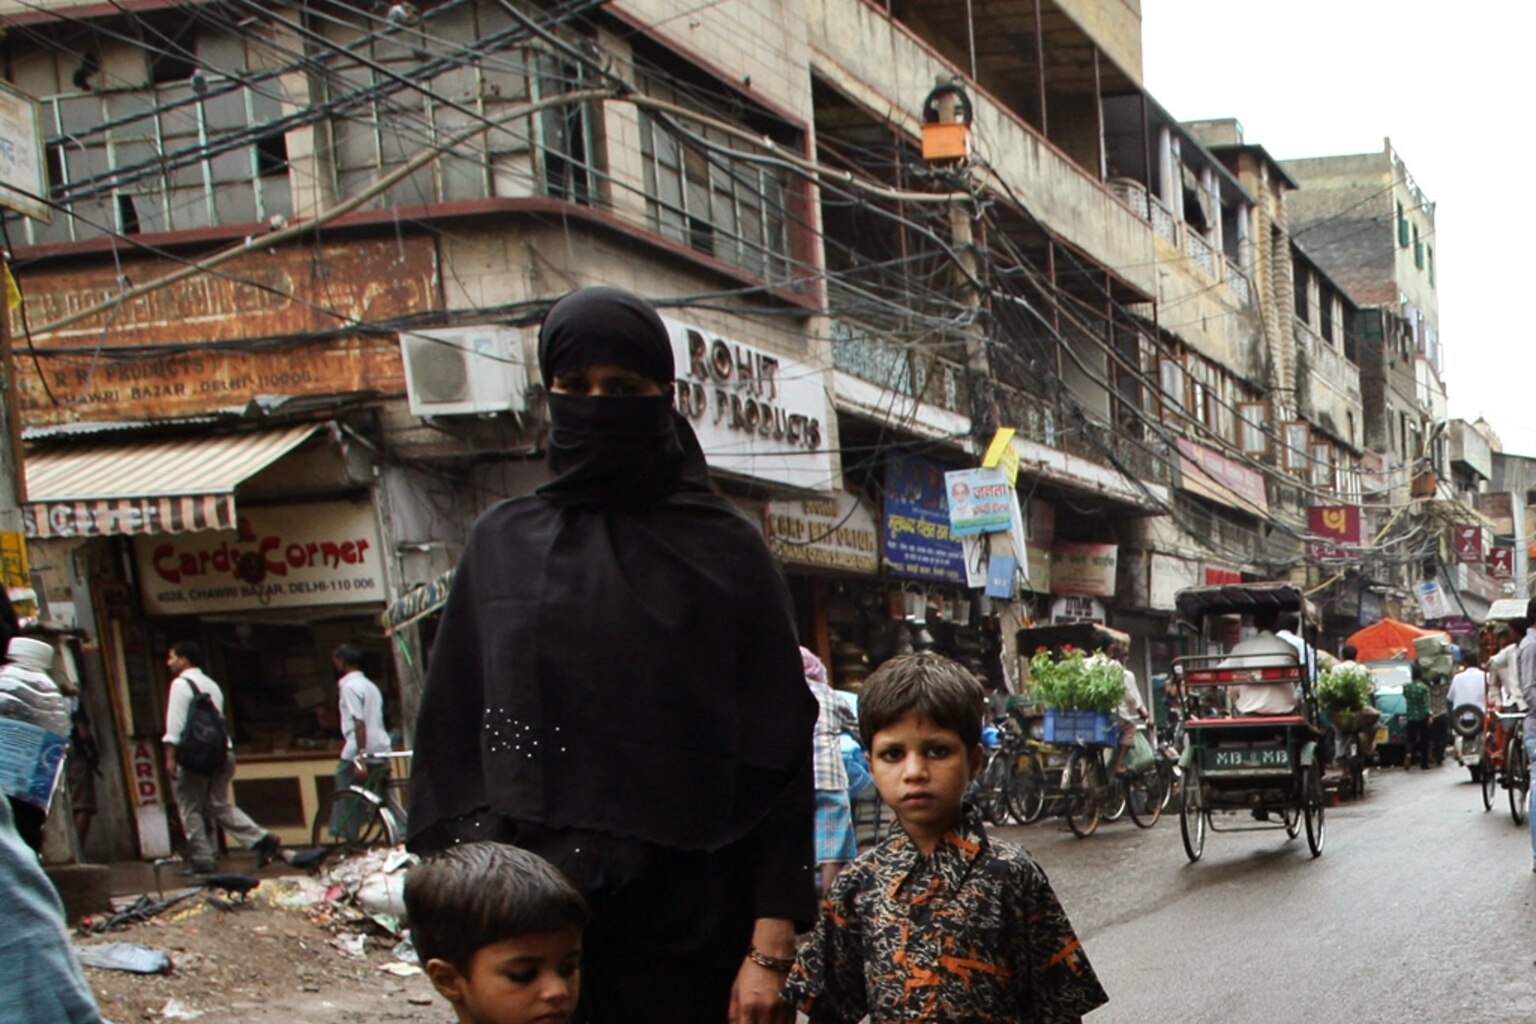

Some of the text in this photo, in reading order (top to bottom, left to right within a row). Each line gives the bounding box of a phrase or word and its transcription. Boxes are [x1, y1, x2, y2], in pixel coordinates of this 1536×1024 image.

[686, 328, 779, 400] ROHIT
[713, 388, 822, 450] PRODUCTS
[49, 503, 158, 538] Corner
[153, 536, 369, 583] Cards Corner
[189, 586, 239, 602] CHAWRI
